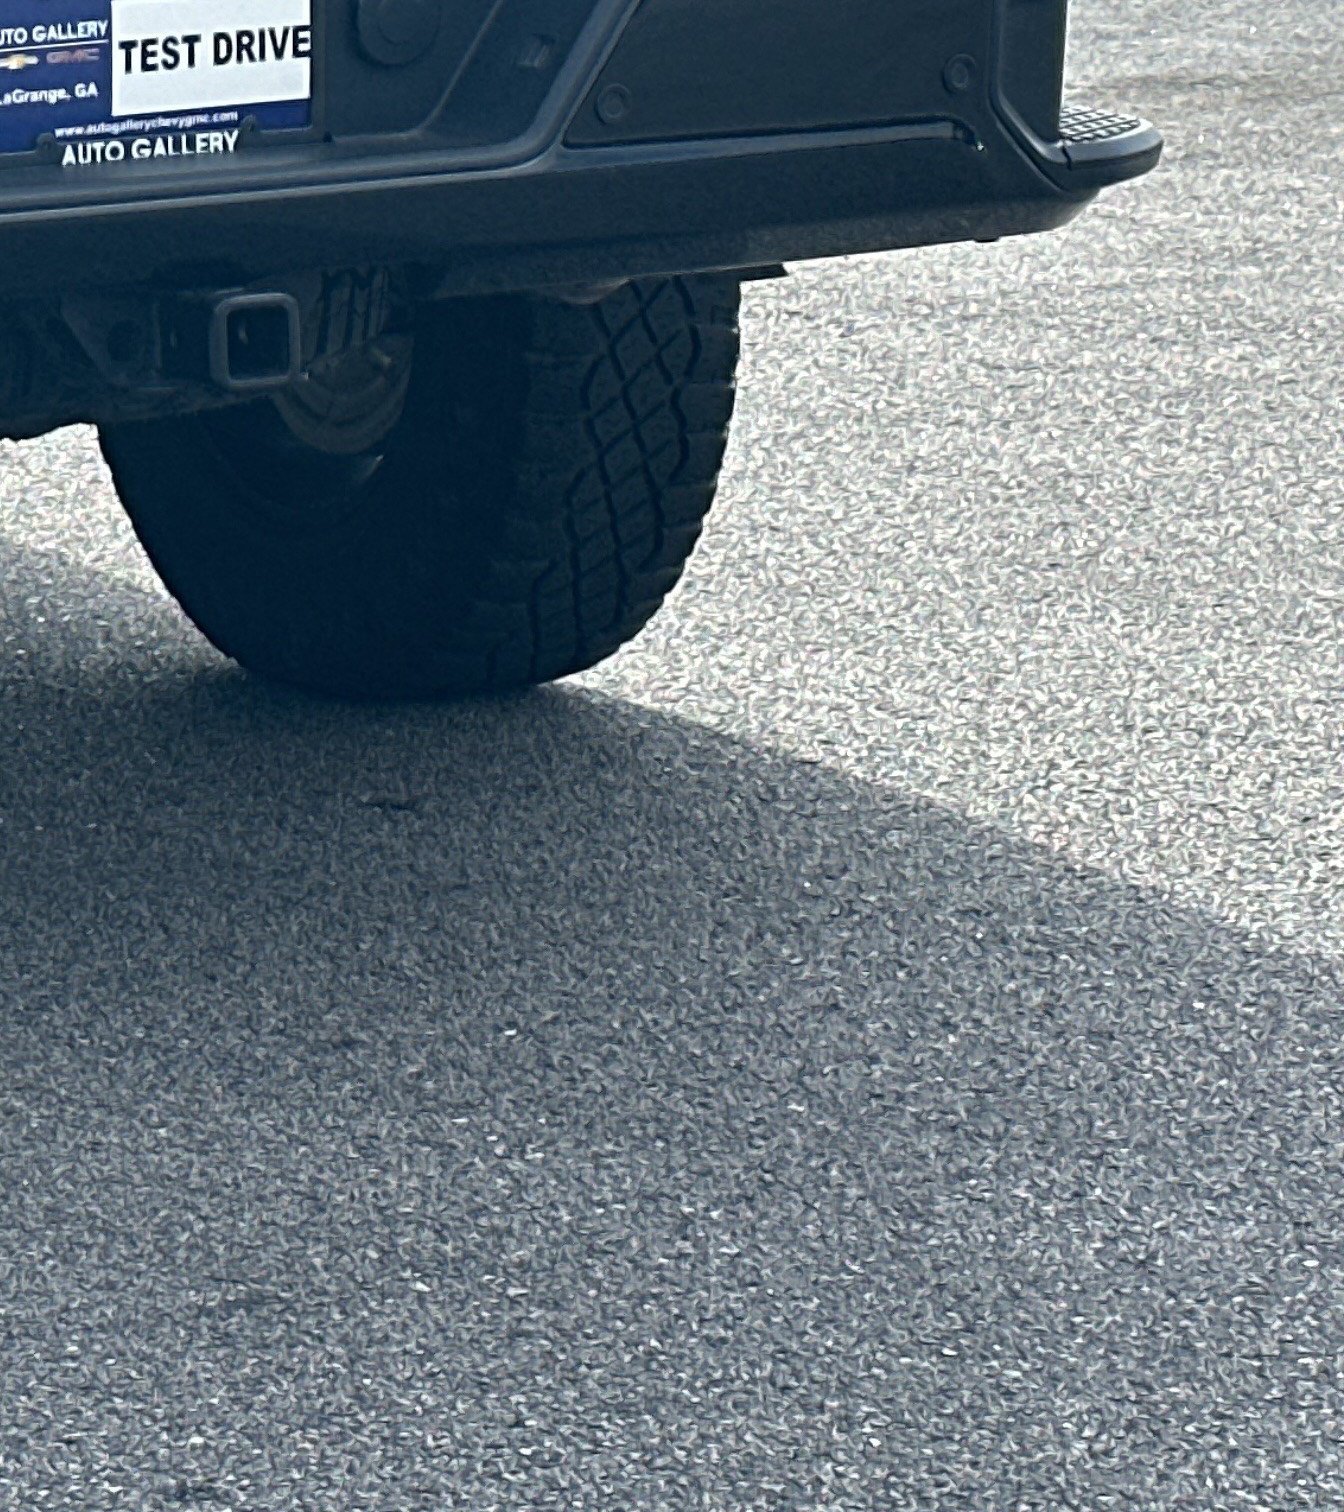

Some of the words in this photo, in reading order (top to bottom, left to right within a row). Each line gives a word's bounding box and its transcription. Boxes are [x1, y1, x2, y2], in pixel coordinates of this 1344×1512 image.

[32, 19, 108, 43] GALLERY
[118, 34, 202, 74] TEST
[212, 25, 311, 66] DRIVE
[74, 81, 98, 98] GA
[62, 140, 125, 167] AUTO
[130, 129, 239, 160] GALLERY
